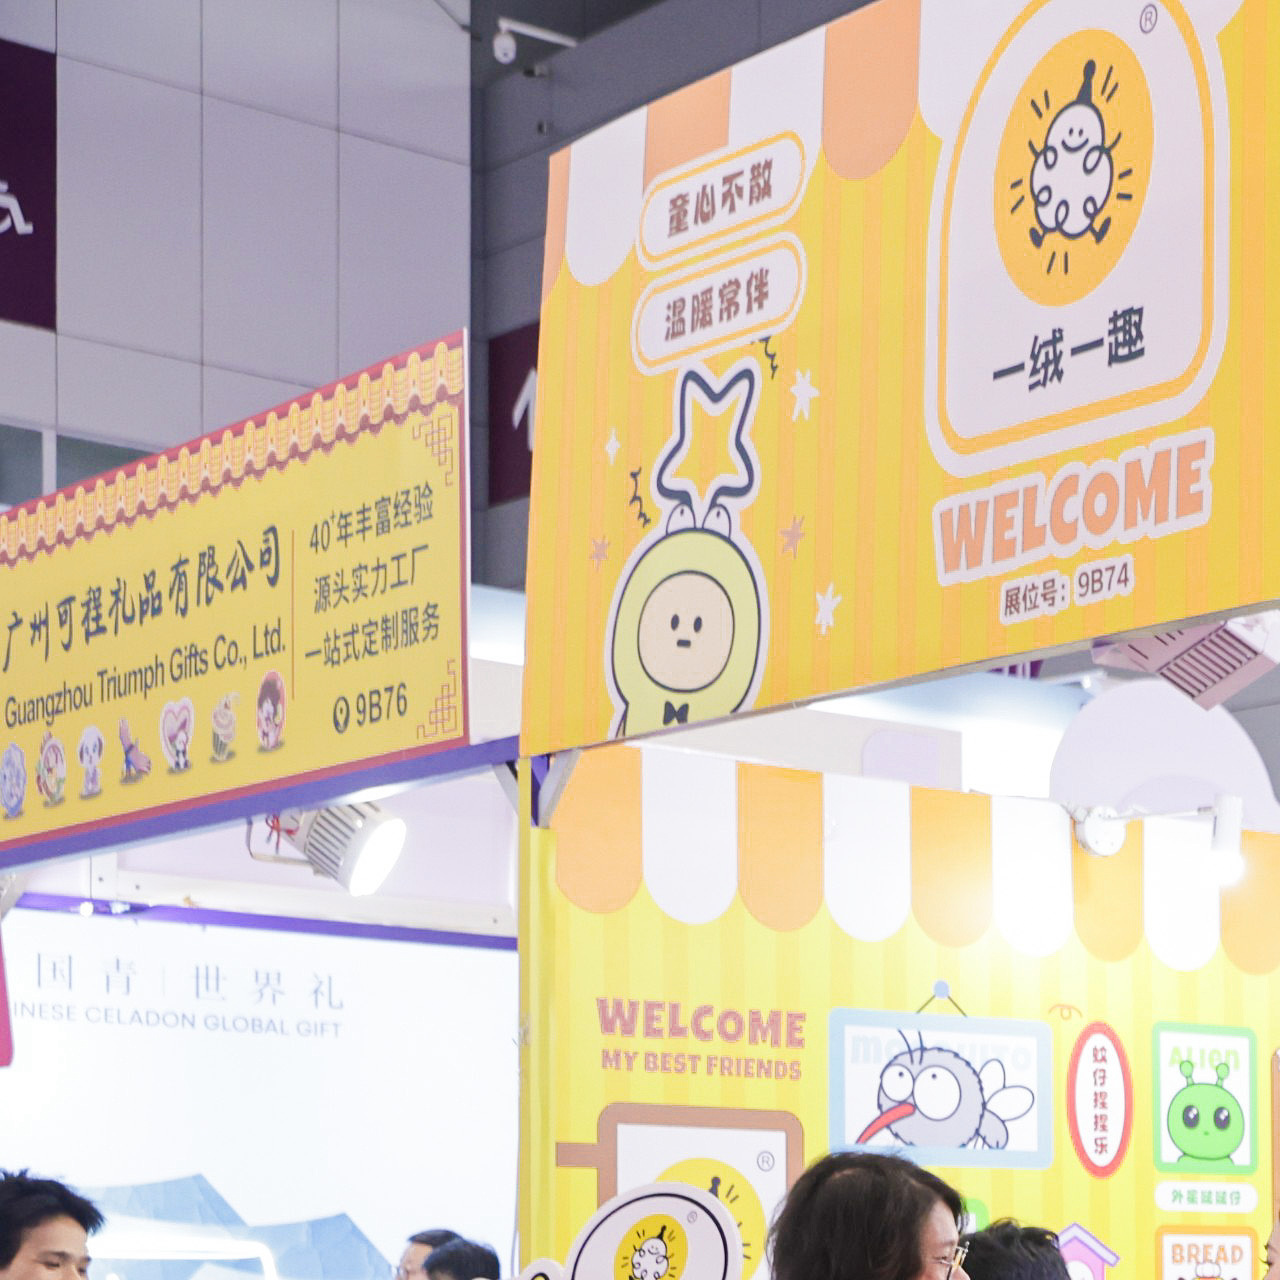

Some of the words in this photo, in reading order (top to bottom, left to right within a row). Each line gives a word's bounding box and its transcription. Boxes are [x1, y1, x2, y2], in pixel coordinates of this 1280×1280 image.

[666, 157, 775, 238] 童心不散
[664, 270, 770, 342] 温暖常伴
[992, 306, 1145, 392] 一绒一趣
[939, 439, 1207, 575] WELCOME
[2, 524, 283, 674] 广州可程礼品有限公司
[314, 544, 429, 613] 源头实力工厂
[304, 601, 441, 664] 一站式定制服务
[4, 682, 94, 730] Guangzhou
[96, 658, 166, 707] Triumph
[169, 640, 210, 682] Gifts
[252, 618, 286, 657] Ltd.
[355, 689, 408, 727] 9B76
[13, 1002, 76, 1022] INESE
[85, 1006, 196, 1029] CELADON
[204, 1012, 290, 1036] GLOBAL
[297, 1019, 343, 1040] GIFT
[596, 996, 807, 1048] WELCOME
[601, 1048, 640, 1072] MY
[645, 1052, 700, 1075] BEST
[706, 1055, 802, 1081] FRIENDS
[1171, 1243, 1244, 1266] BREAD
